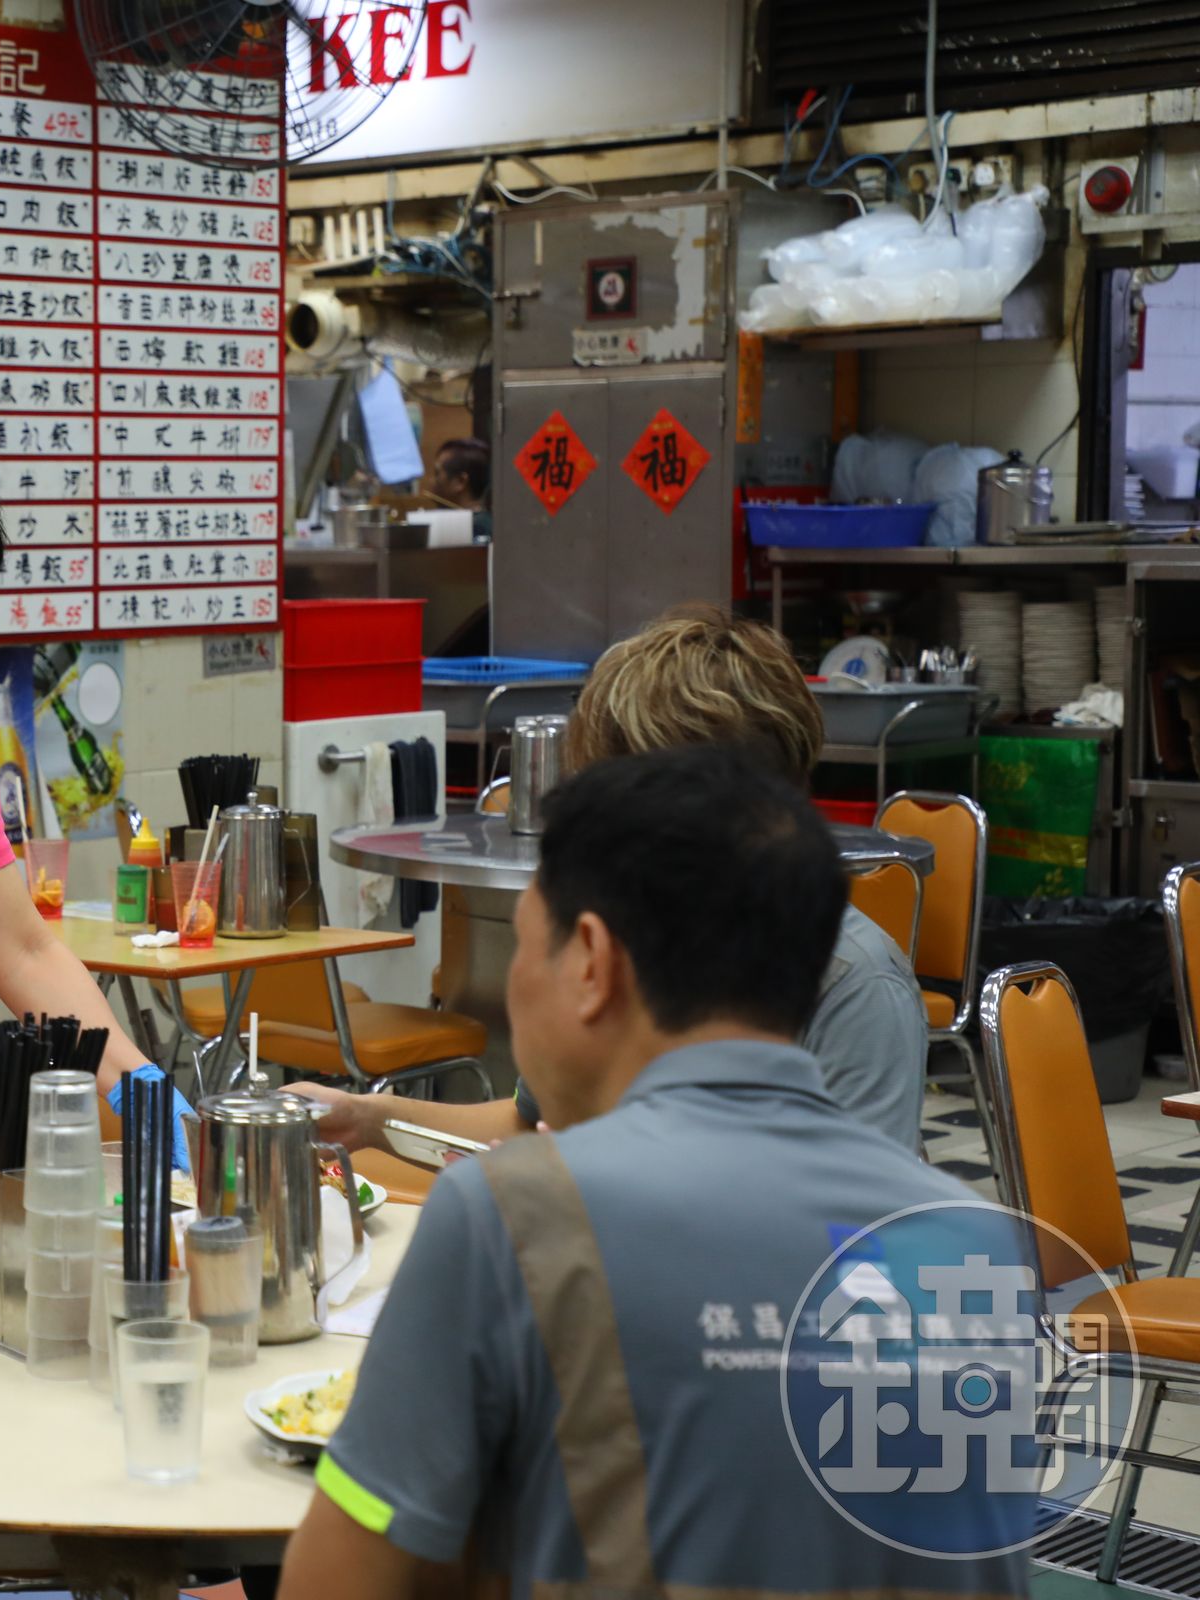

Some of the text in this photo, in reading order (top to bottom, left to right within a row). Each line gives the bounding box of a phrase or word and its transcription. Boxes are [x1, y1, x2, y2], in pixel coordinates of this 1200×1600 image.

[307, 0, 475, 94] KEE
[530, 436, 575, 492] 福
[640, 432, 687, 492] 福
